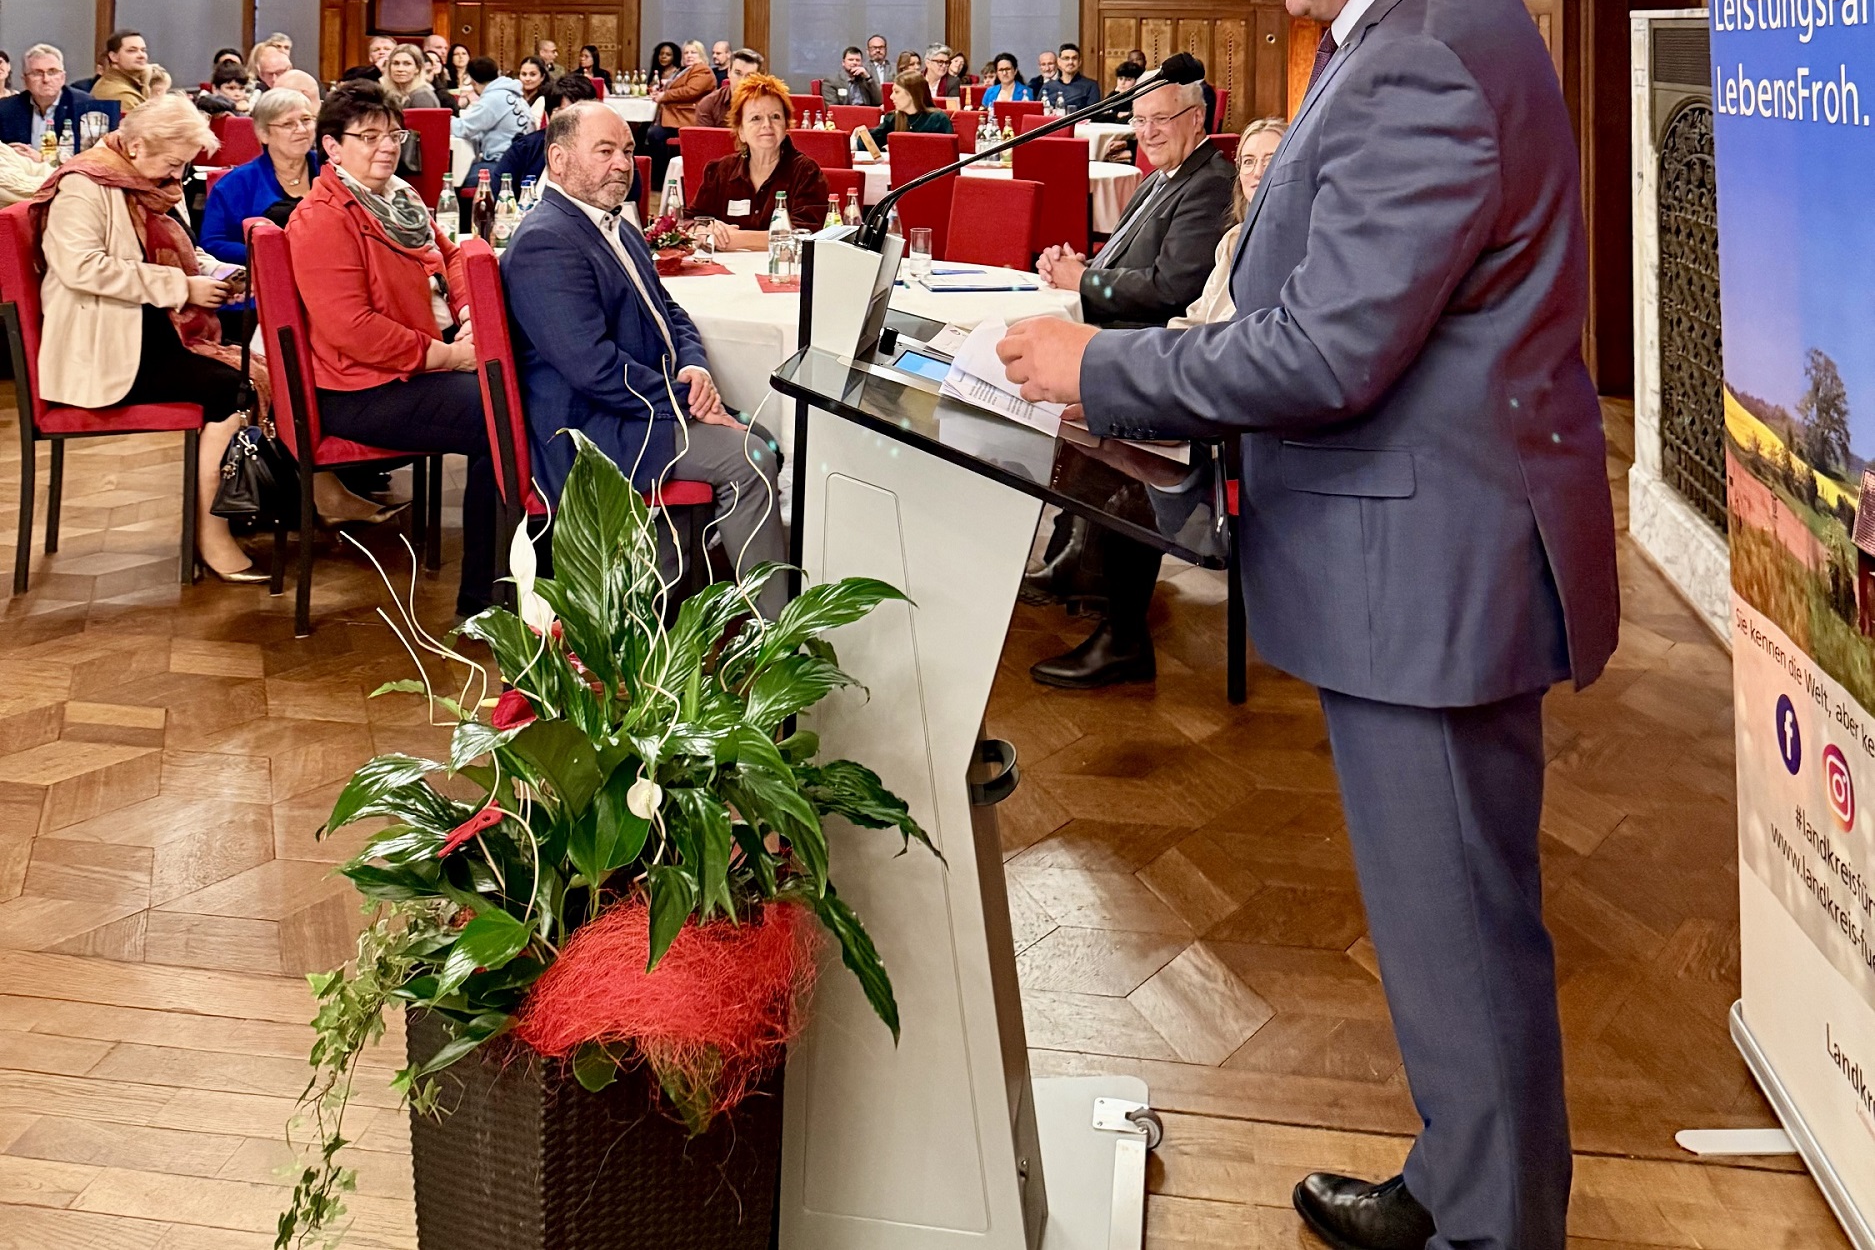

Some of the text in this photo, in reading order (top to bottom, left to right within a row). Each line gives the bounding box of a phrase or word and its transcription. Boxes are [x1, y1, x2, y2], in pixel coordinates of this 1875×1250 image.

[1717, 63, 1870, 126] LebensFroh.
[1736, 608, 1748, 635] Sie
[1750, 619, 1787, 668] kennen
[1788, 656, 1802, 685] die
[1804, 669, 1832, 718] Welt,
[1836, 703, 1858, 740] aber
[1795, 804, 1875, 918] #landkreisfür
[1826, 1022, 1875, 1120] Landkr
